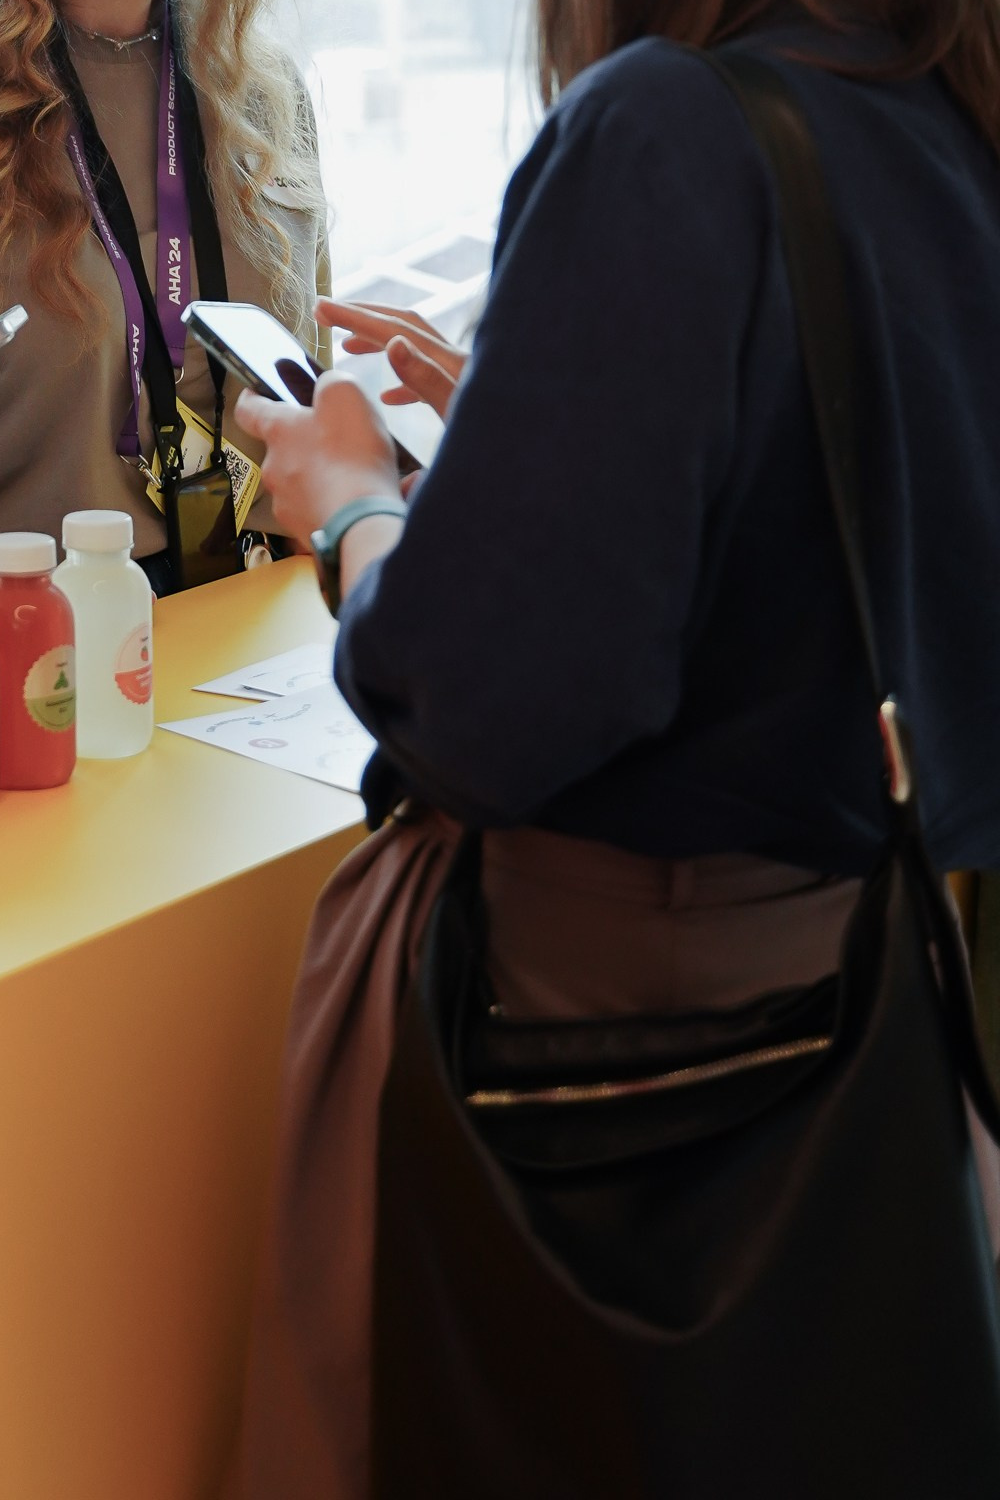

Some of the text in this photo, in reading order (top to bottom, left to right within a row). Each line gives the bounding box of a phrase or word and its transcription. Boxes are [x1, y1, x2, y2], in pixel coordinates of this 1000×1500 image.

[168, 110, 177, 176] PRODUCT
[70, 134, 121, 260] PRODUCT SCIENCE
[167, 237, 181, 306] AHA'24
